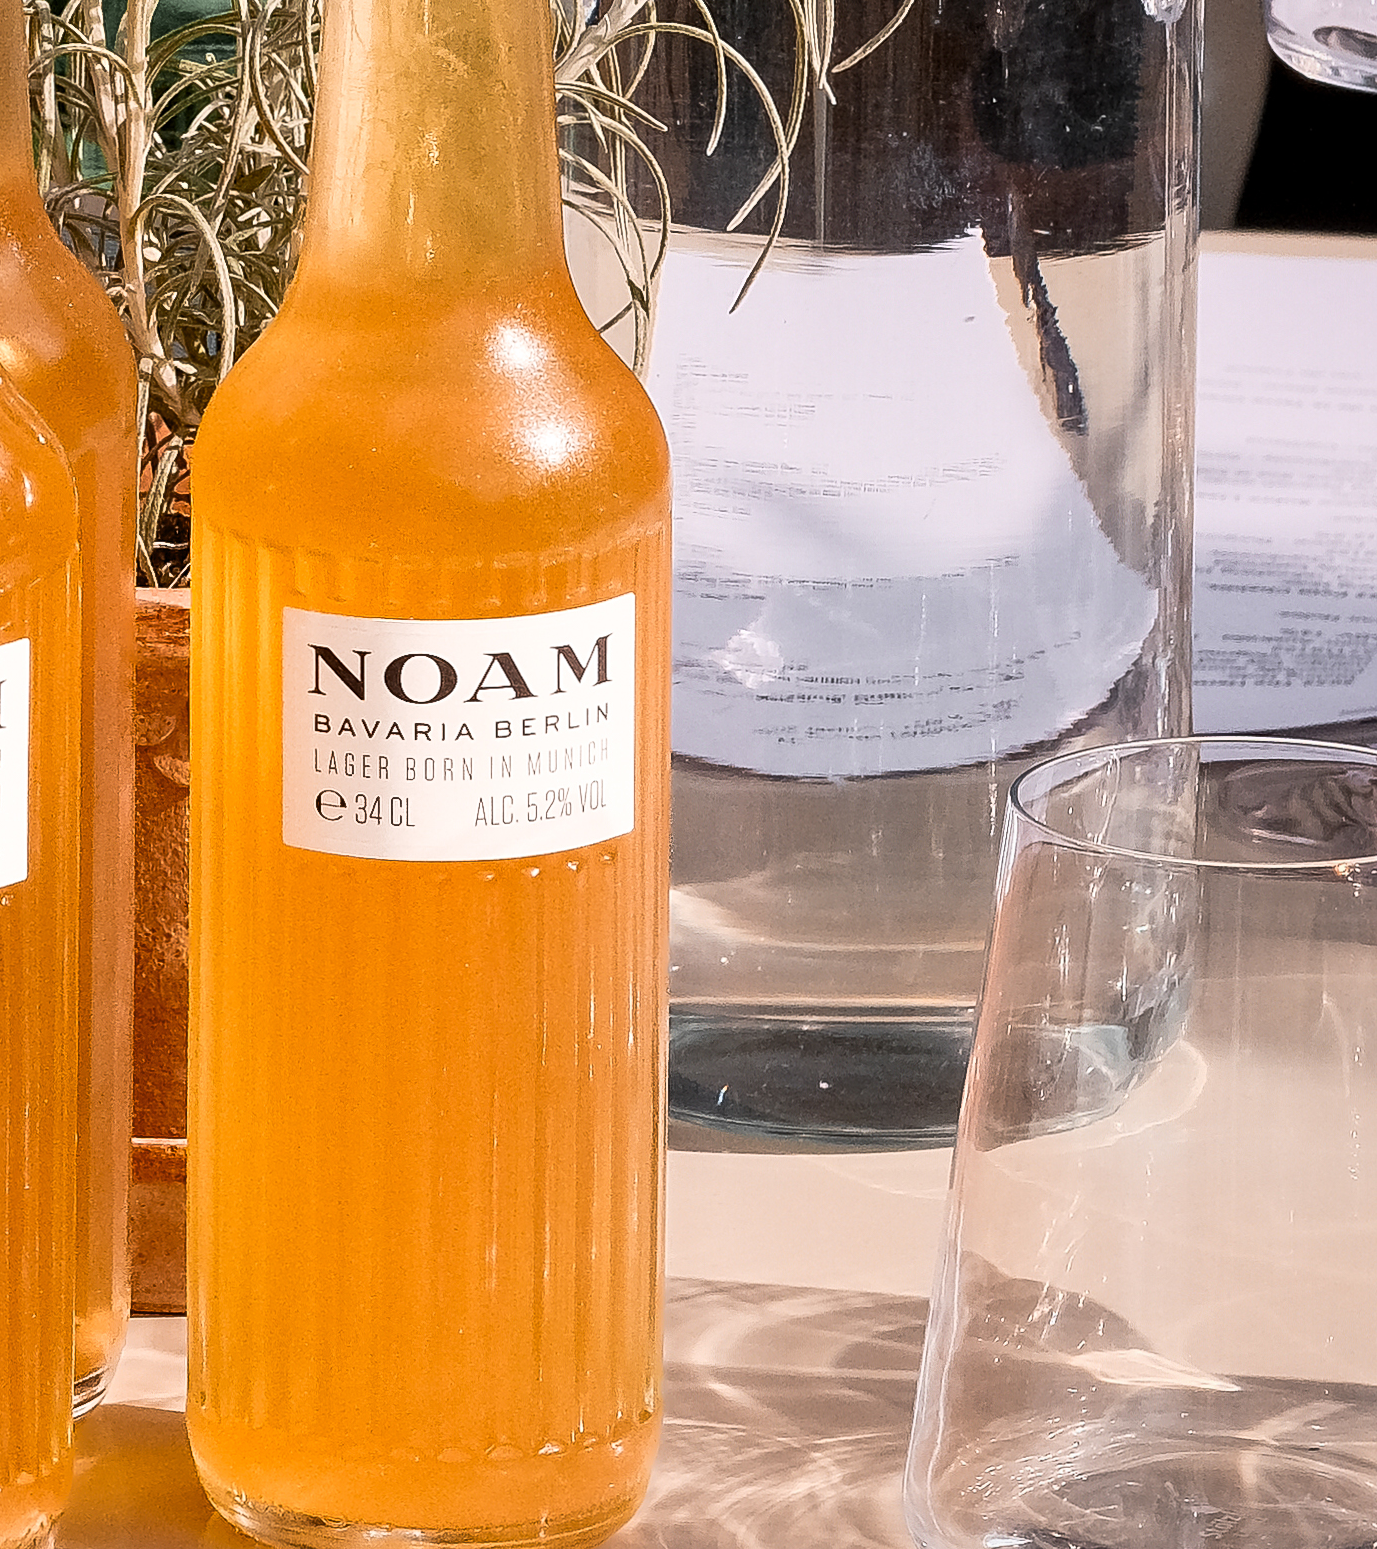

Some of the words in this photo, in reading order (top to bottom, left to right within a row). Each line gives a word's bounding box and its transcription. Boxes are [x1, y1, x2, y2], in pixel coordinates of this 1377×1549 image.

[307, 632, 613, 704] NOAM
[314, 713, 474, 741] BAVARIA
[495, 702, 609, 739] BERLIN
[314, 748, 389, 780] LAGER
[405, 756, 473, 782] BORN
[489, 755, 512, 780] IN
[527, 737, 609, 775] MUNICH
[526, 788, 573, 824] 5.2%
